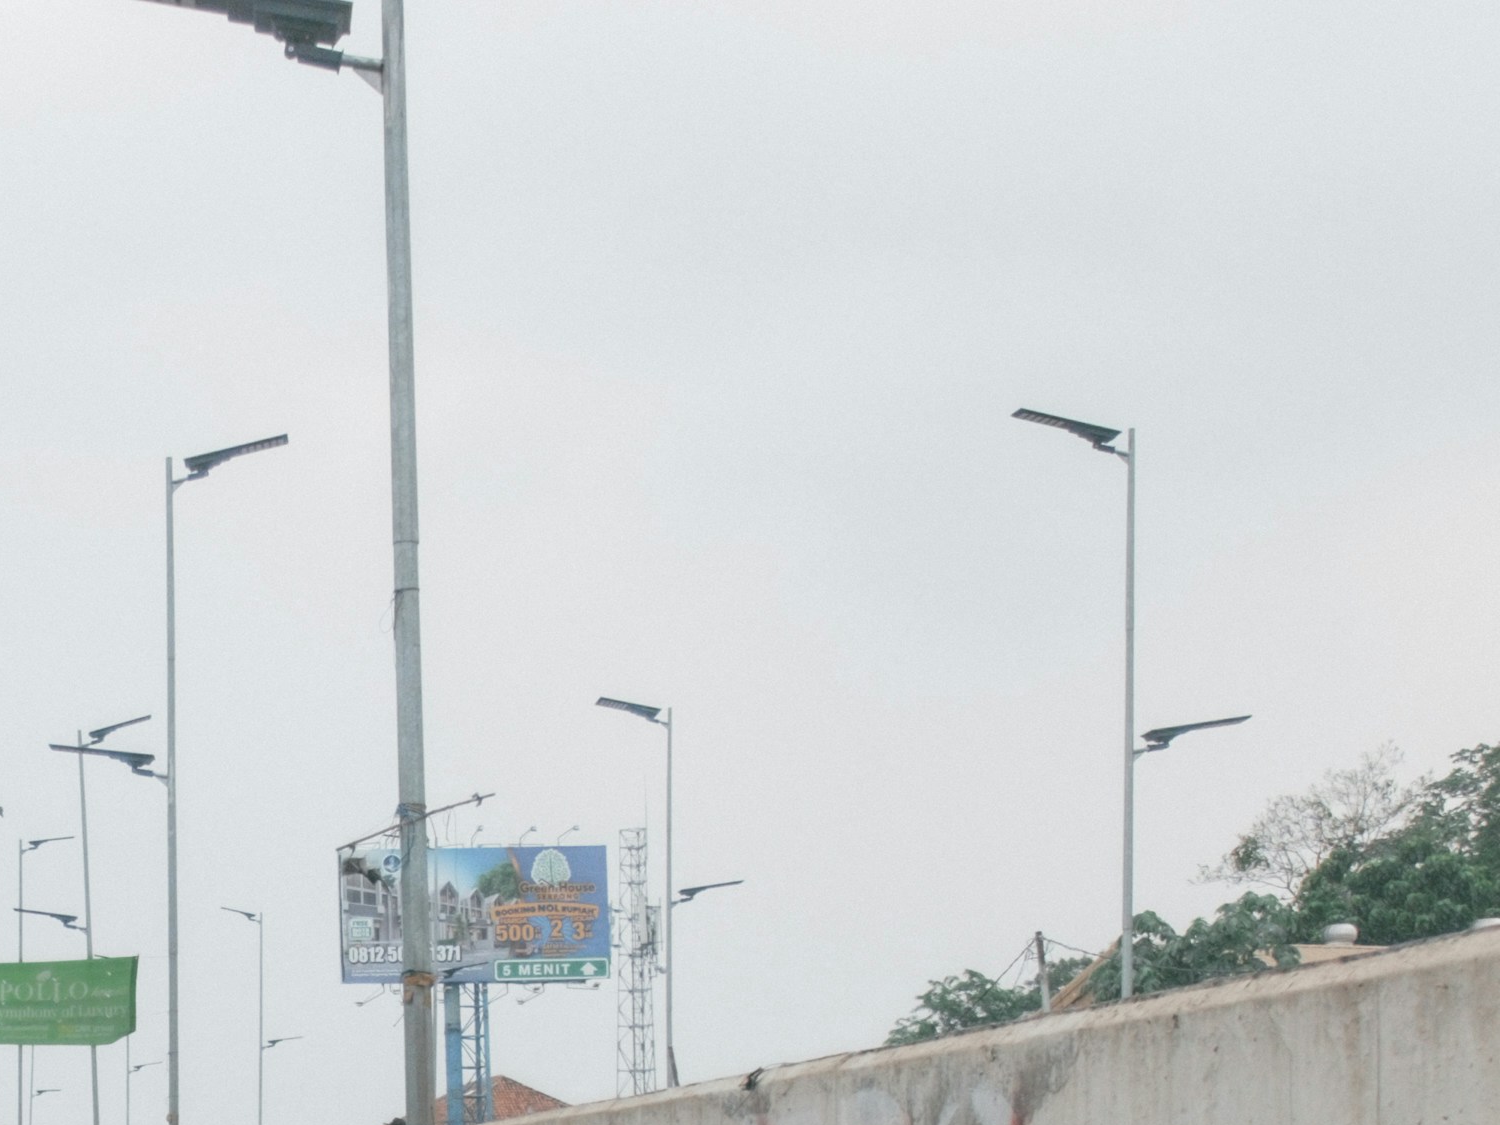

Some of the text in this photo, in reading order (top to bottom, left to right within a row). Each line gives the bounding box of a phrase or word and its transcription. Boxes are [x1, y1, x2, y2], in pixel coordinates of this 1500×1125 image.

[559, 881, 596, 892] House
[537, 904, 559, 914] NOL
[496, 925, 535, 941] 500
[348, 946, 385, 963] 0812
[502, 963, 571, 976] 5 MENIT
